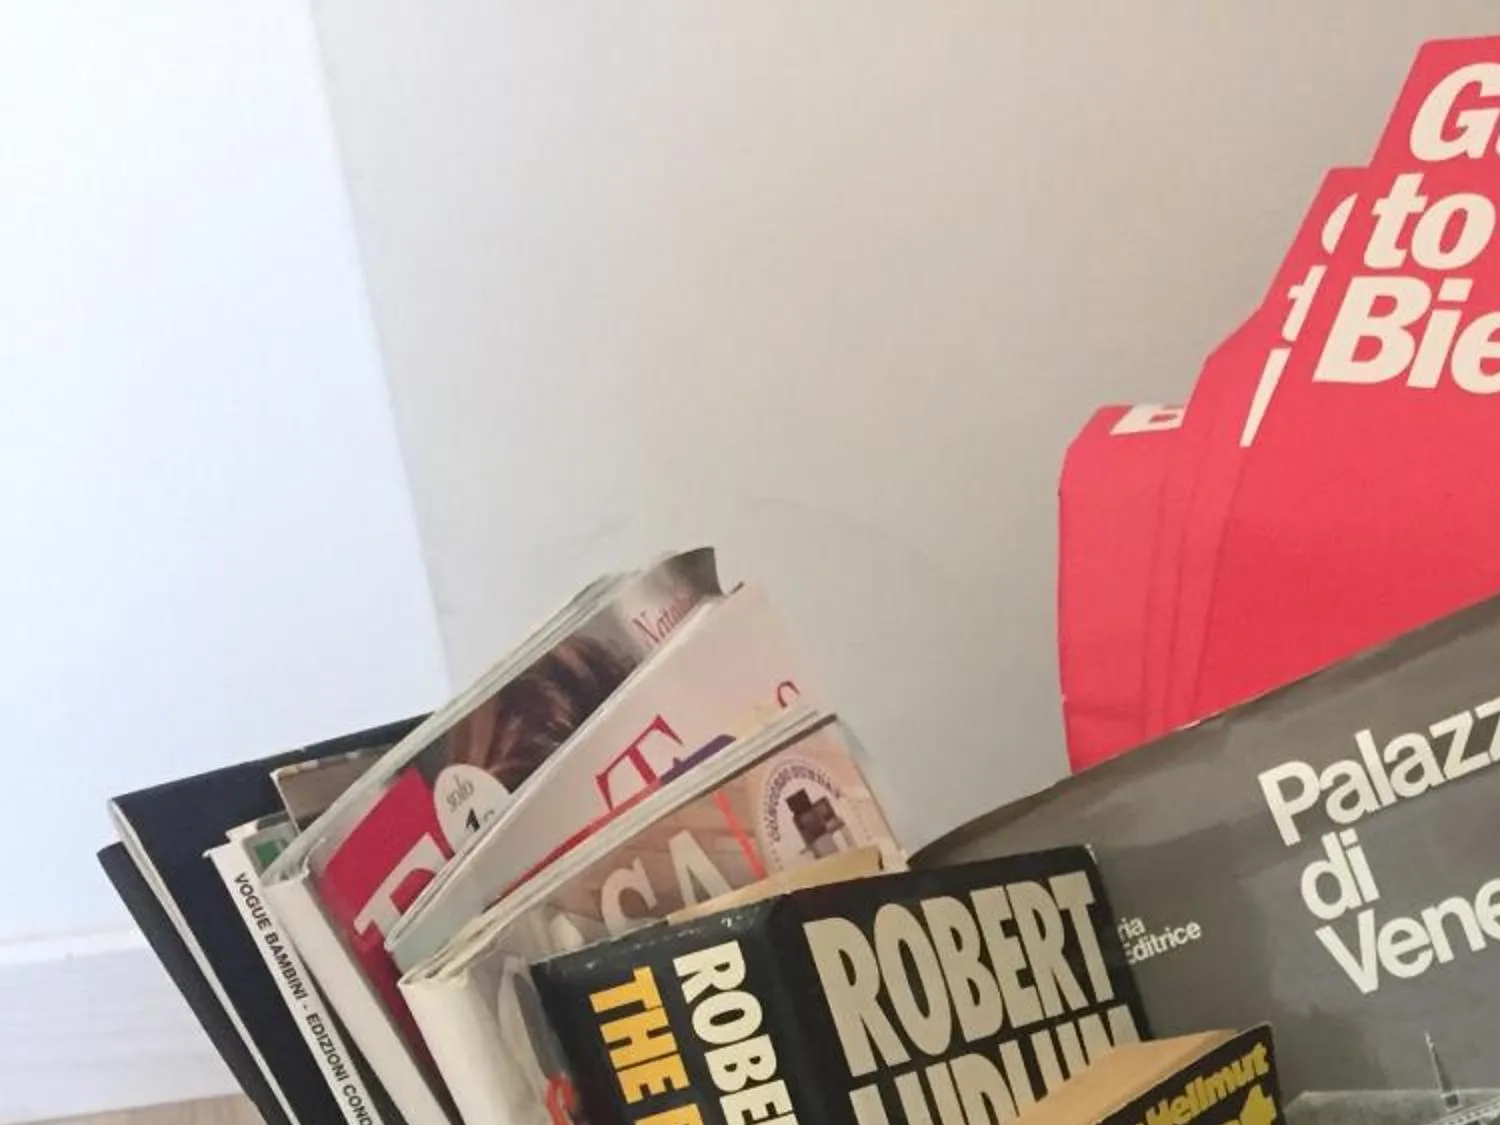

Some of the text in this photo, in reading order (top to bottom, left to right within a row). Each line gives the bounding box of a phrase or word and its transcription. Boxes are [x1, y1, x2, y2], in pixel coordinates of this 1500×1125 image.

[1363, 172, 1496, 270] to
[1301, 827, 1380, 920] di
[234, 872, 272, 934] VOGUE
[264, 932, 309, 1002] BAMBINI
[305, 1013, 351, 1084] EDIZIONI
[589, 965, 690, 1104] THE
[802, 870, 1114, 1077] ROBERT
